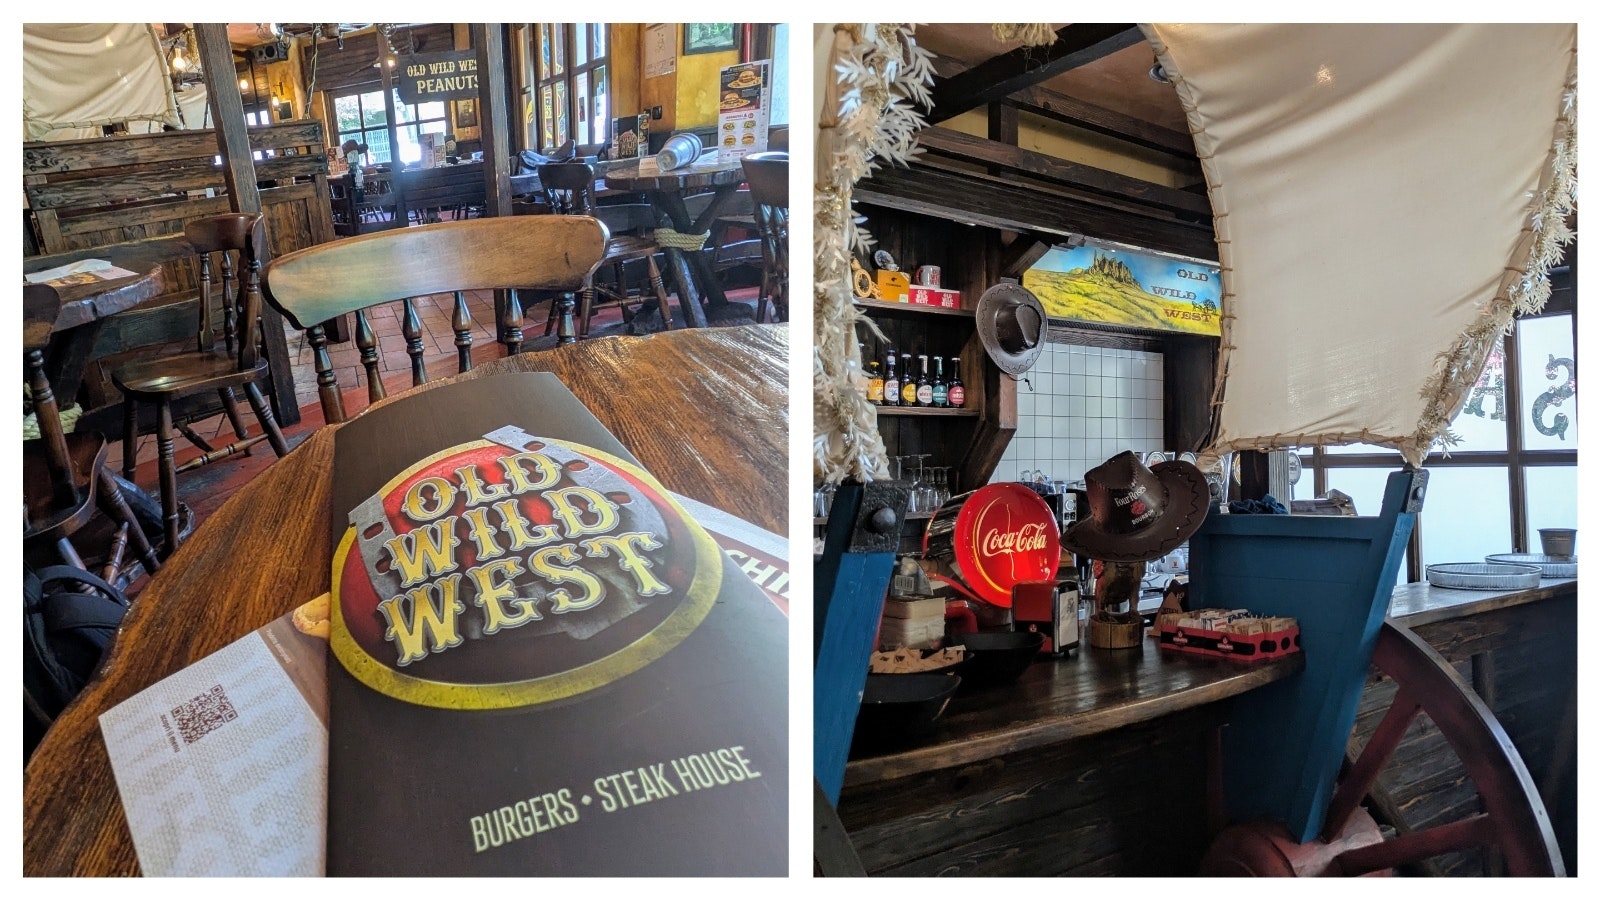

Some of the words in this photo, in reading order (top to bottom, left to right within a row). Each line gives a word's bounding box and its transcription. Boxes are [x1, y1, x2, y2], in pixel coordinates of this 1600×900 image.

[407, 64, 426, 77] OLD
[429, 61, 456, 75] WILD
[458, 59, 477, 72] WES
[416, 74, 478, 94] PEANUTS
[1177, 268, 1209, 281] OLD
[1150, 285, 1197, 300] WILD
[1163, 308, 1211, 322] WEST
[401, 452, 562, 522] OLD
[1114, 496, 1130, 507] Four
[1131, 508, 1154, 525] BOURBON
[382, 486, 621, 589] WILD
[983, 522, 1048, 557] Coca-Cola
[377, 531, 673, 667] WEST
[470, 788, 580, 853] BURGERS
[594, 763, 679, 812] STEAK
[671, 745, 762, 792] HOUSE
